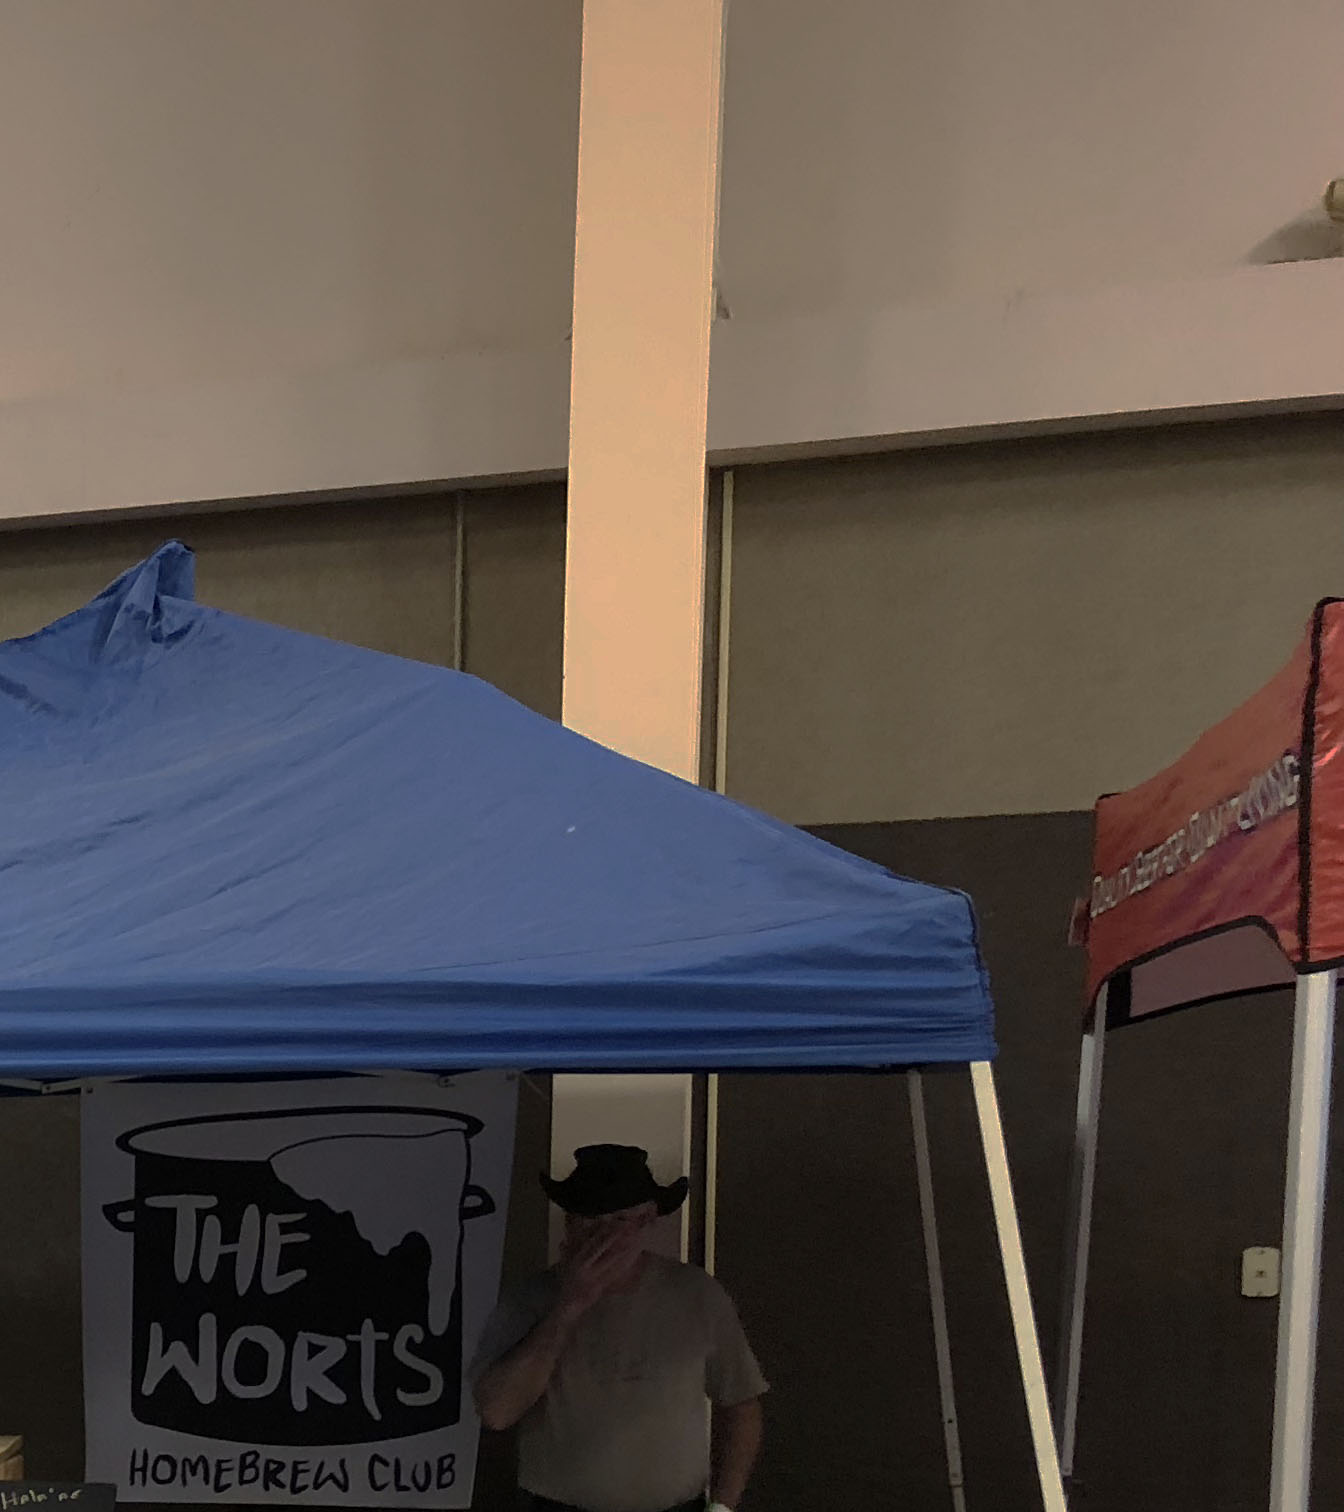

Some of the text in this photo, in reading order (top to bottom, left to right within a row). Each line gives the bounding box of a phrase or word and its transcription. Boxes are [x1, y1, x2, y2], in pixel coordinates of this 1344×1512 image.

[144, 1194, 311, 1297] THE
[141, 1312, 444, 1421] WORTS
[129, 1448, 456, 1493] HOMEBREW CLUB
